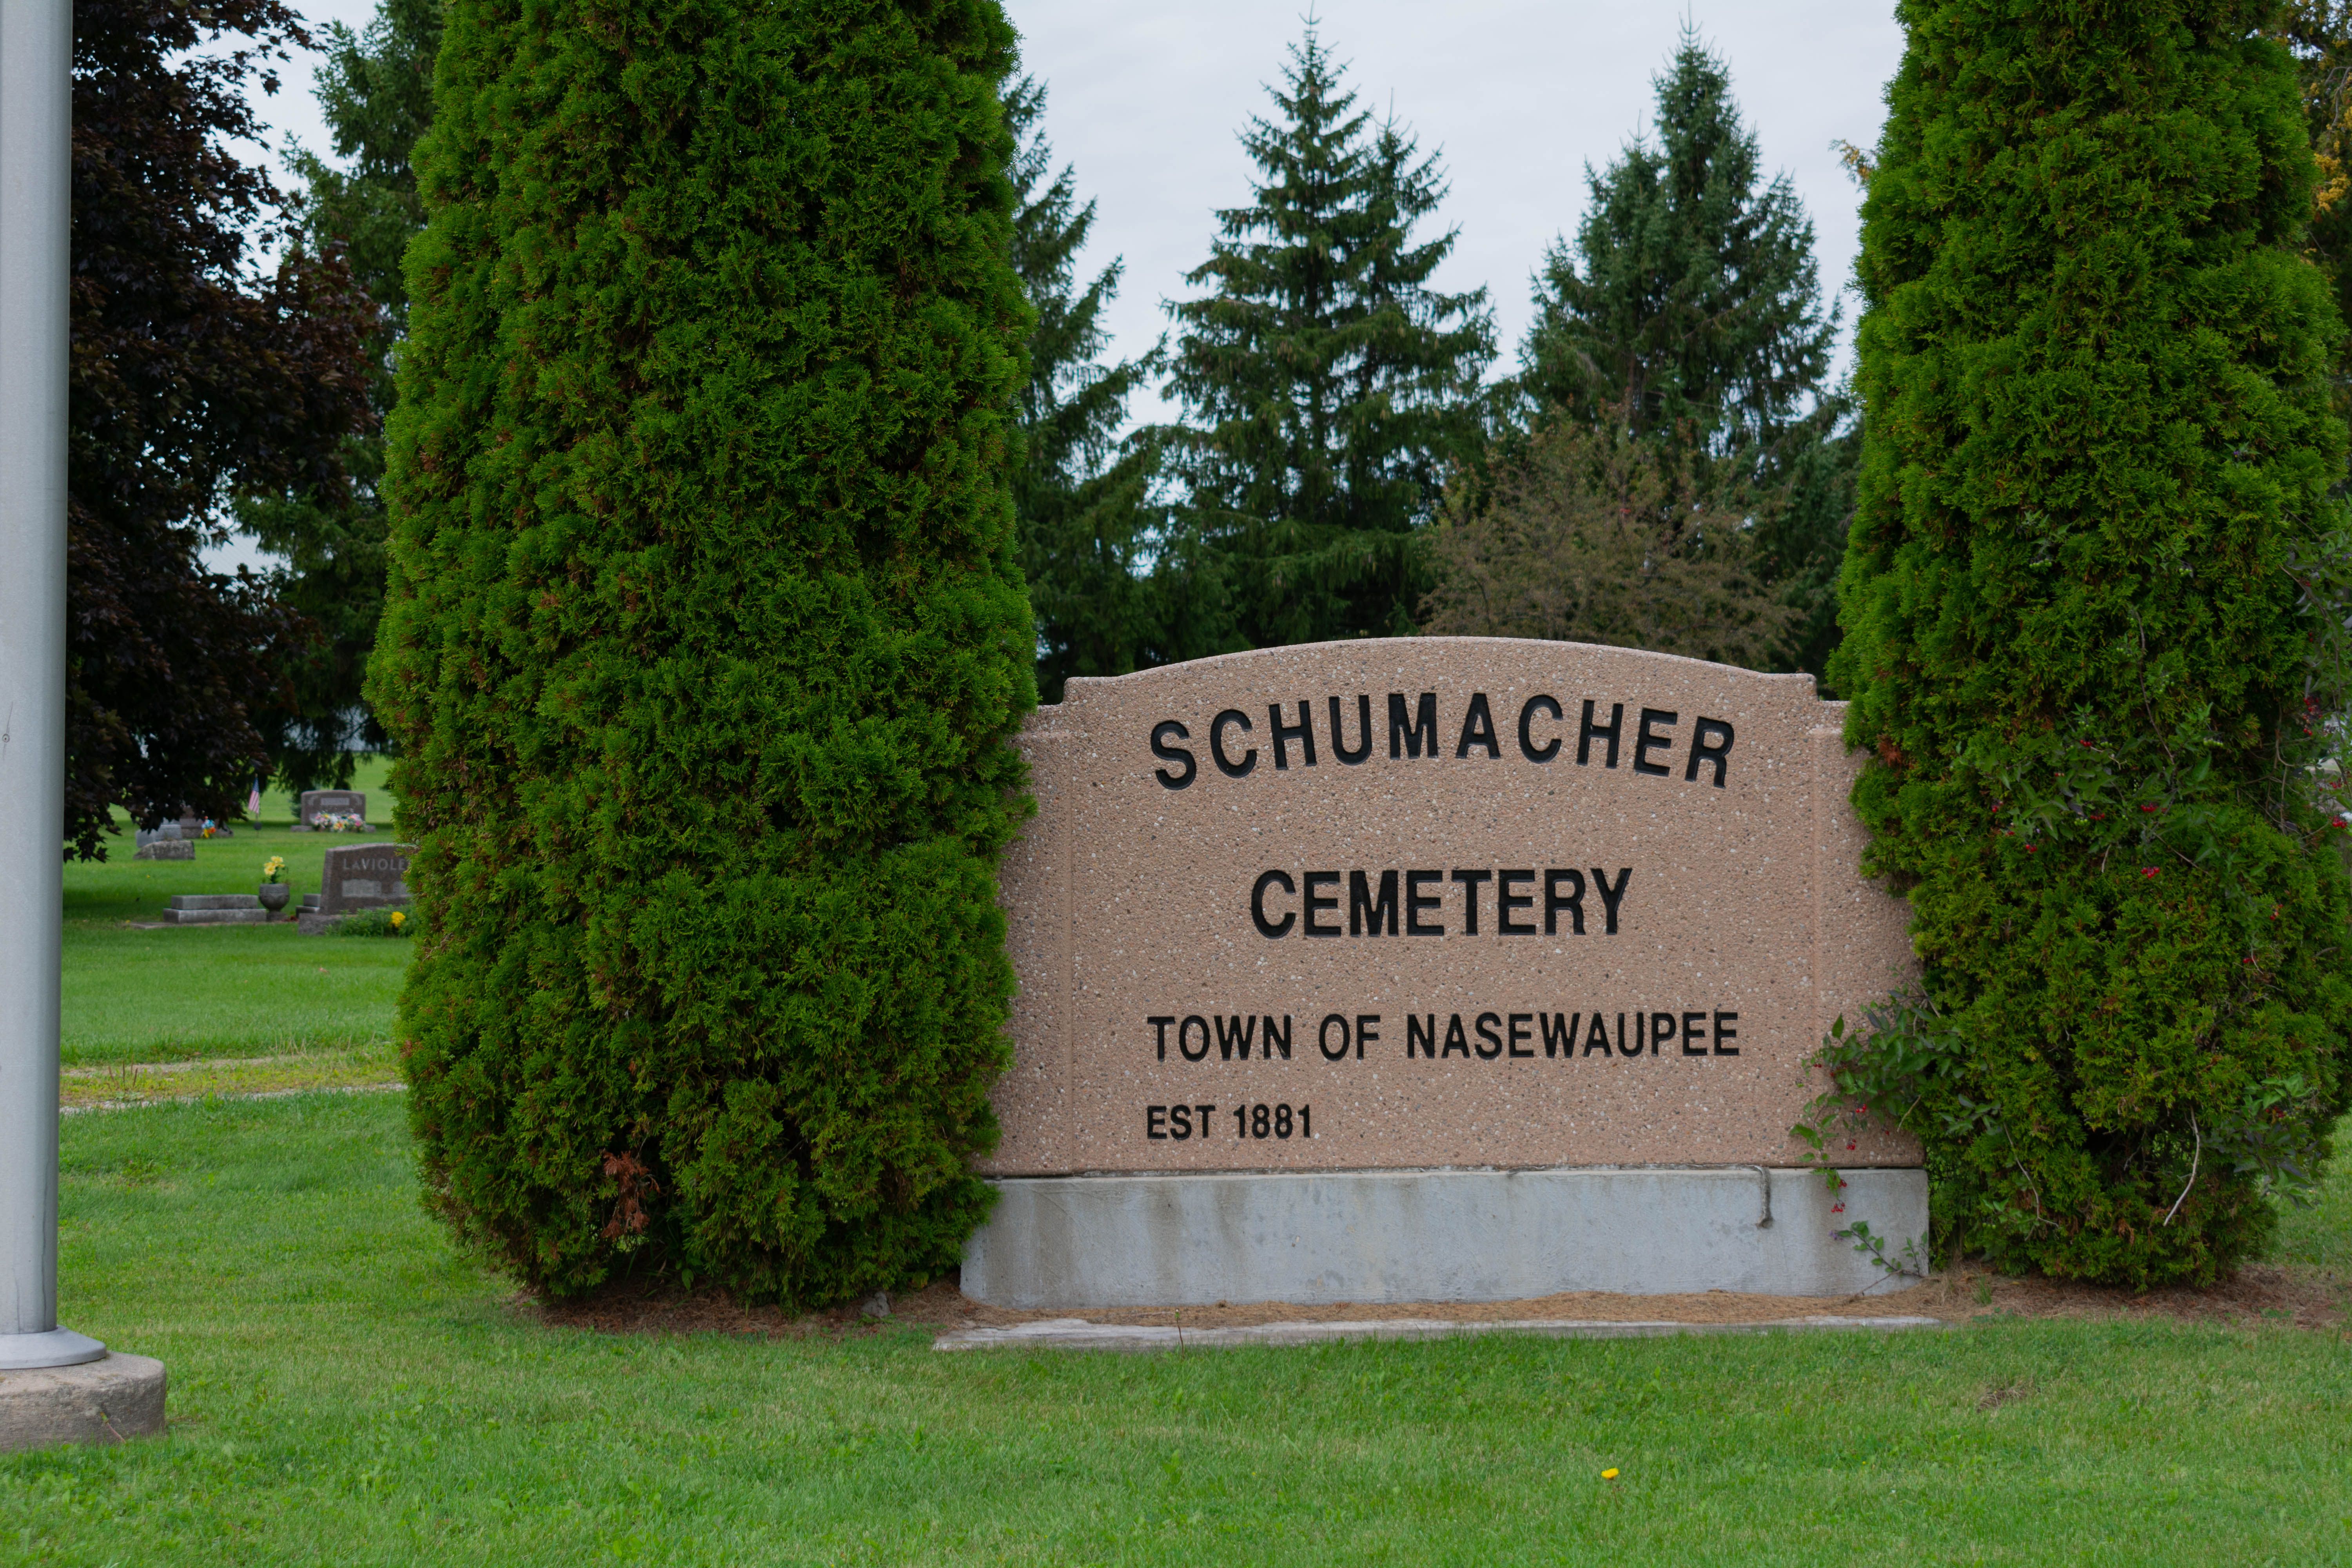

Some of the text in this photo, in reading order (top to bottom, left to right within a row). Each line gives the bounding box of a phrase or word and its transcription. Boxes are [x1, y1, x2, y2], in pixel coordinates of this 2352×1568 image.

[1149, 691, 1735, 791] SCHUMACHER
[343, 858, 407, 871] LAVIOLE
[1249, 867, 1633, 939] CEMETERY
[1146, 1011, 1740, 1062] TOWN OF NASEWAUPEE
[1146, 1103, 1311, 1141] EST 1881
